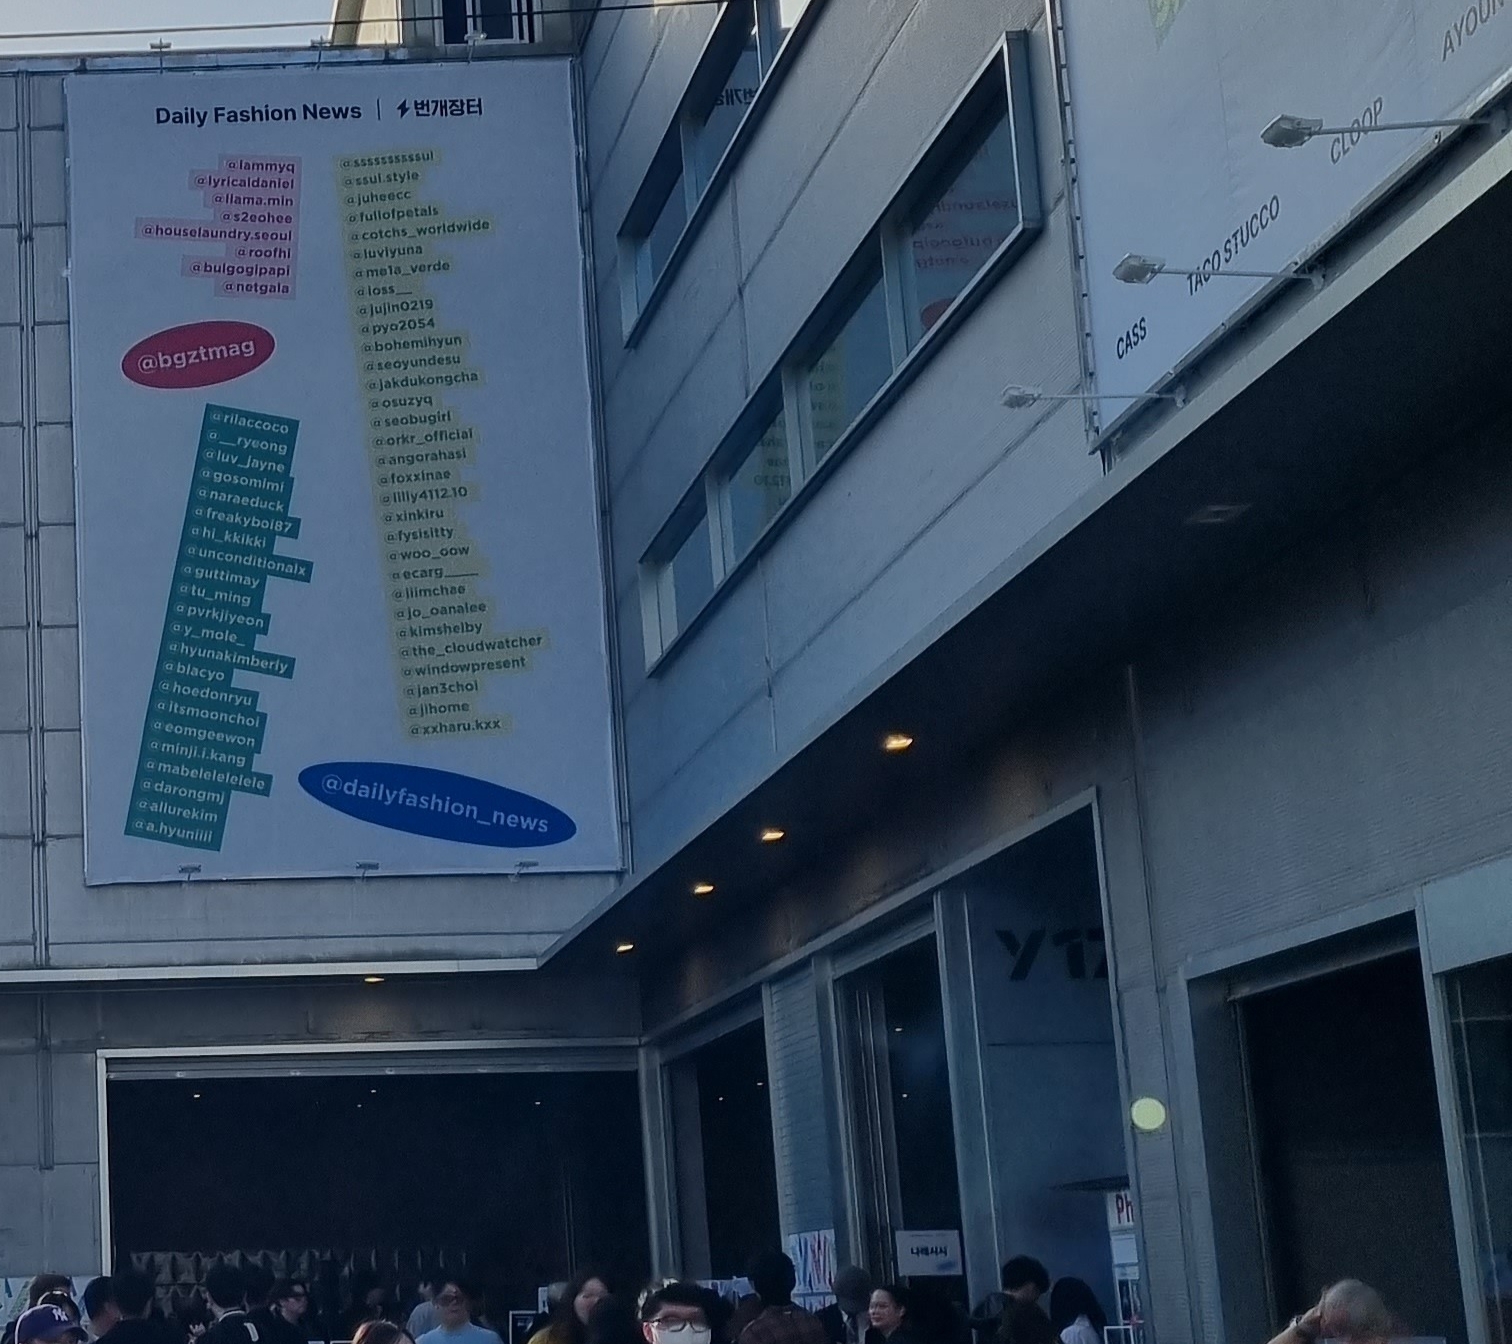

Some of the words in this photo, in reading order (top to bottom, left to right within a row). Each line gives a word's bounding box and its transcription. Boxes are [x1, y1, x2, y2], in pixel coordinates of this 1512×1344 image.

[155, 104, 208, 128] Daily
[214, 103, 297, 124] Fashion
[302, 102, 362, 121] News
[413, 97, 483, 117] 번개장터
[1329, 96, 1384, 165] CLOOP
[142, 224, 292, 242] @houselaundry.seoul
[1185, 249, 1222, 298] TACO
[1223, 194, 1280, 266] STUCCO
[223, 281, 289, 295] @netgala
[1115, 316, 1148, 360] CASS
[137, 340, 255, 374] @bgztmag
[197, 486, 284, 513] @naraeduck
[399, 636, 543, 660] @the_cloudwatcher
[402, 656, 527, 679] @windowpresent
[321, 773, 549, 833] @dailyfashion_news
